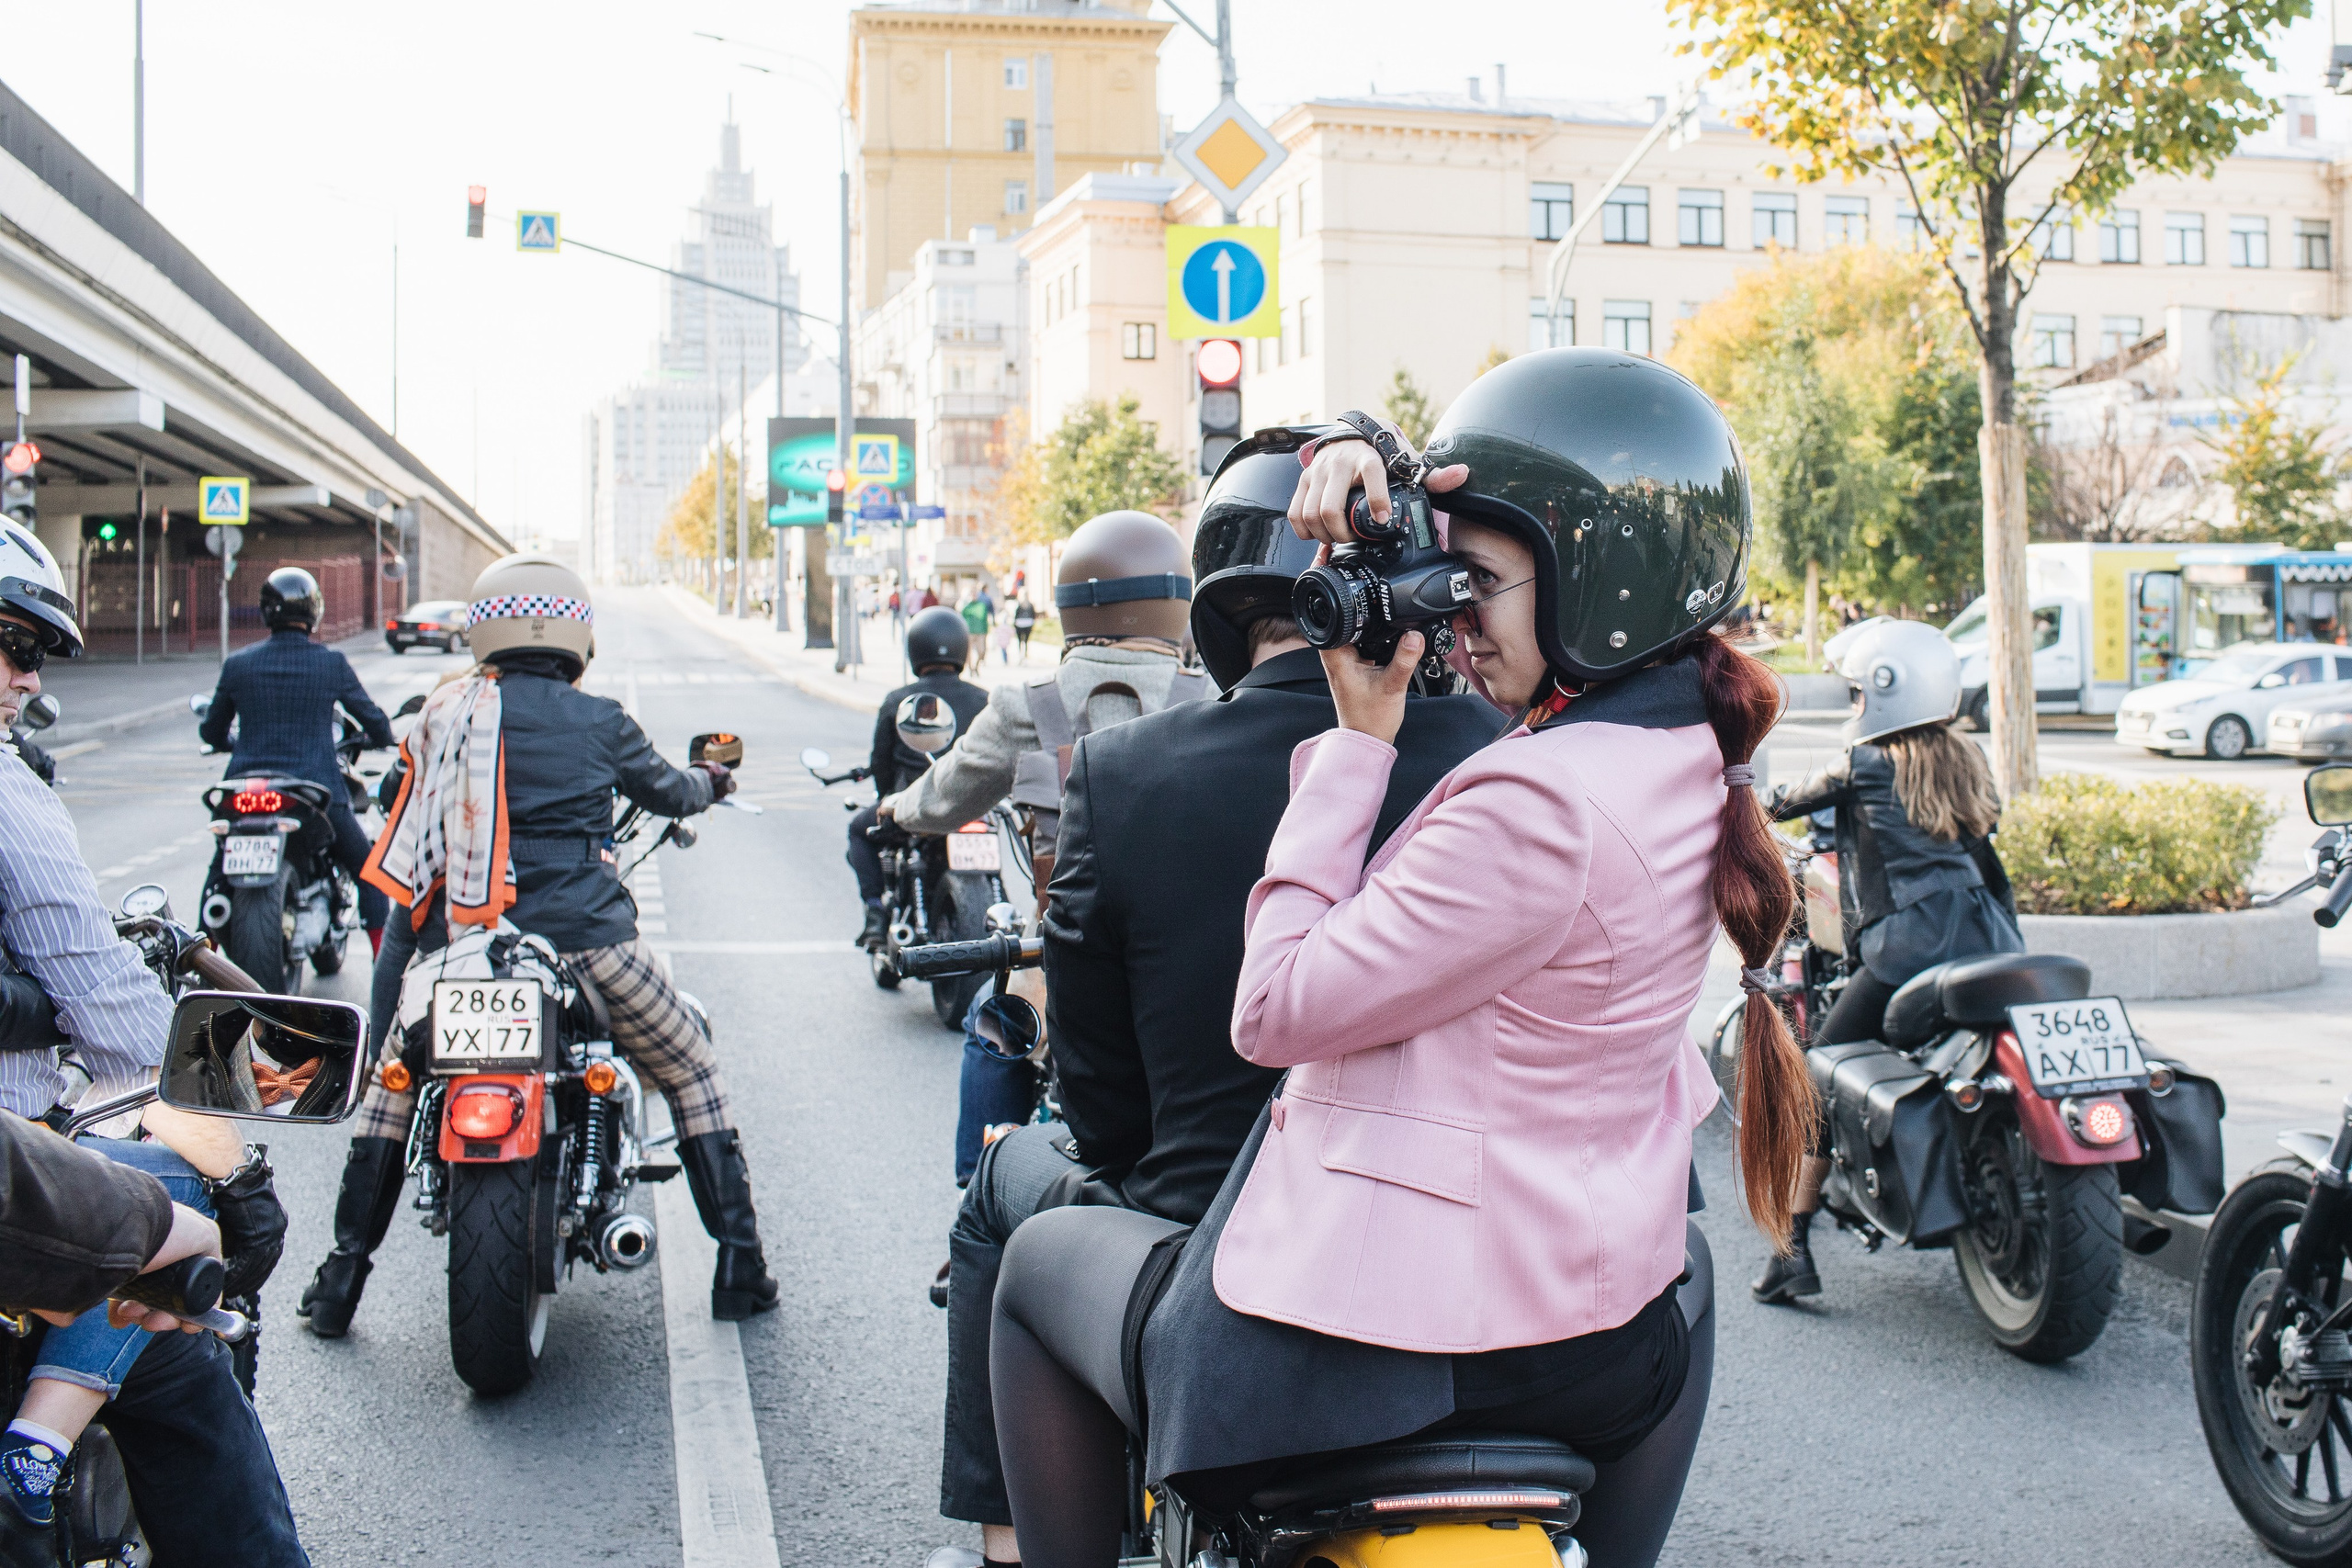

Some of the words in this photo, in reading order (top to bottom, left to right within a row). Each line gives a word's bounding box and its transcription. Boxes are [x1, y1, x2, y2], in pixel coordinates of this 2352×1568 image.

[1379, 583, 1392, 622] Nikon
[257, 856, 274, 869] 77
[449, 988, 526, 1013] 2866
[488, 1015, 511, 1023] RUS
[2031, 1008, 2110, 1037] 3648
[496, 1027, 532, 1052] 77
[2093, 1045, 2128, 1072] 77
